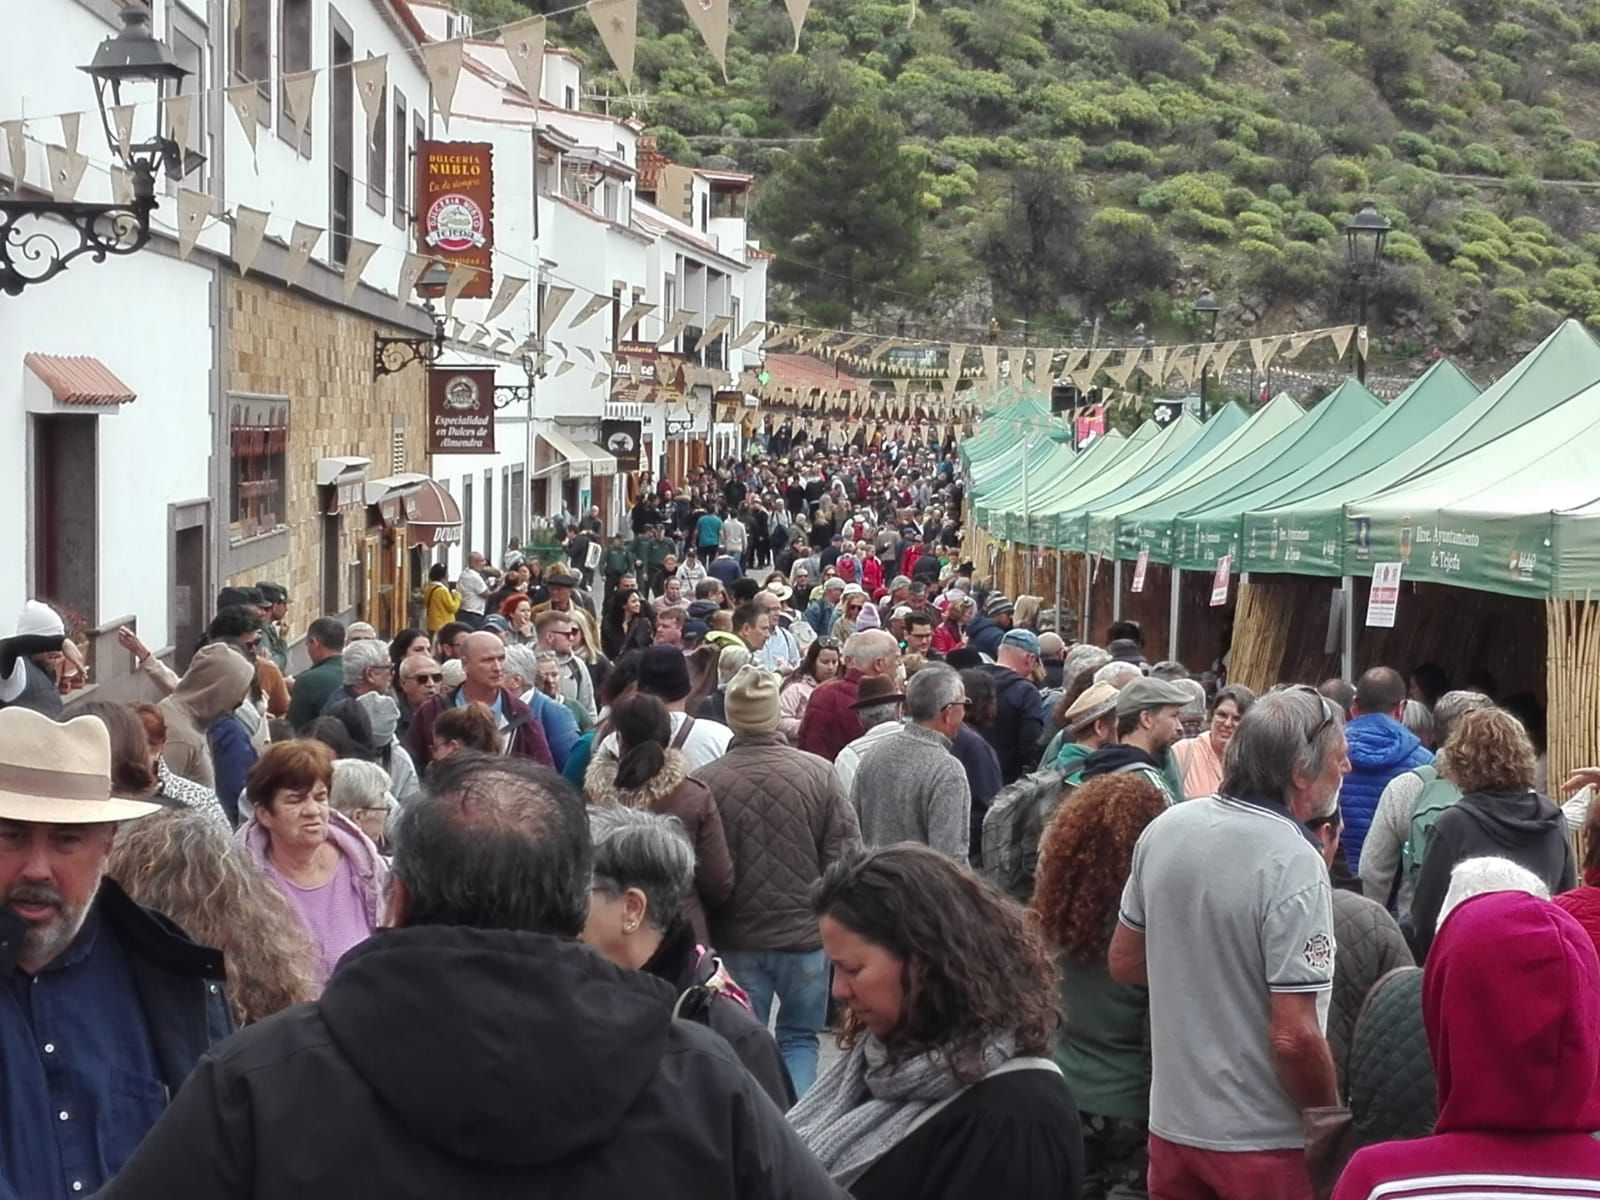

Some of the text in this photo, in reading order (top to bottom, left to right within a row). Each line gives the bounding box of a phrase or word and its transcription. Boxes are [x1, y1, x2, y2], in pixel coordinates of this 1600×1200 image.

[429, 163, 480, 175] NUBLO
[434, 415, 489, 427] Especialidad
[435, 426, 488, 437] en Dulces de
[440, 437, 483, 447] Almendra
[1433, 526, 1480, 548] Ayuntamiento
[1430, 551, 1461, 573] de Tejeda
